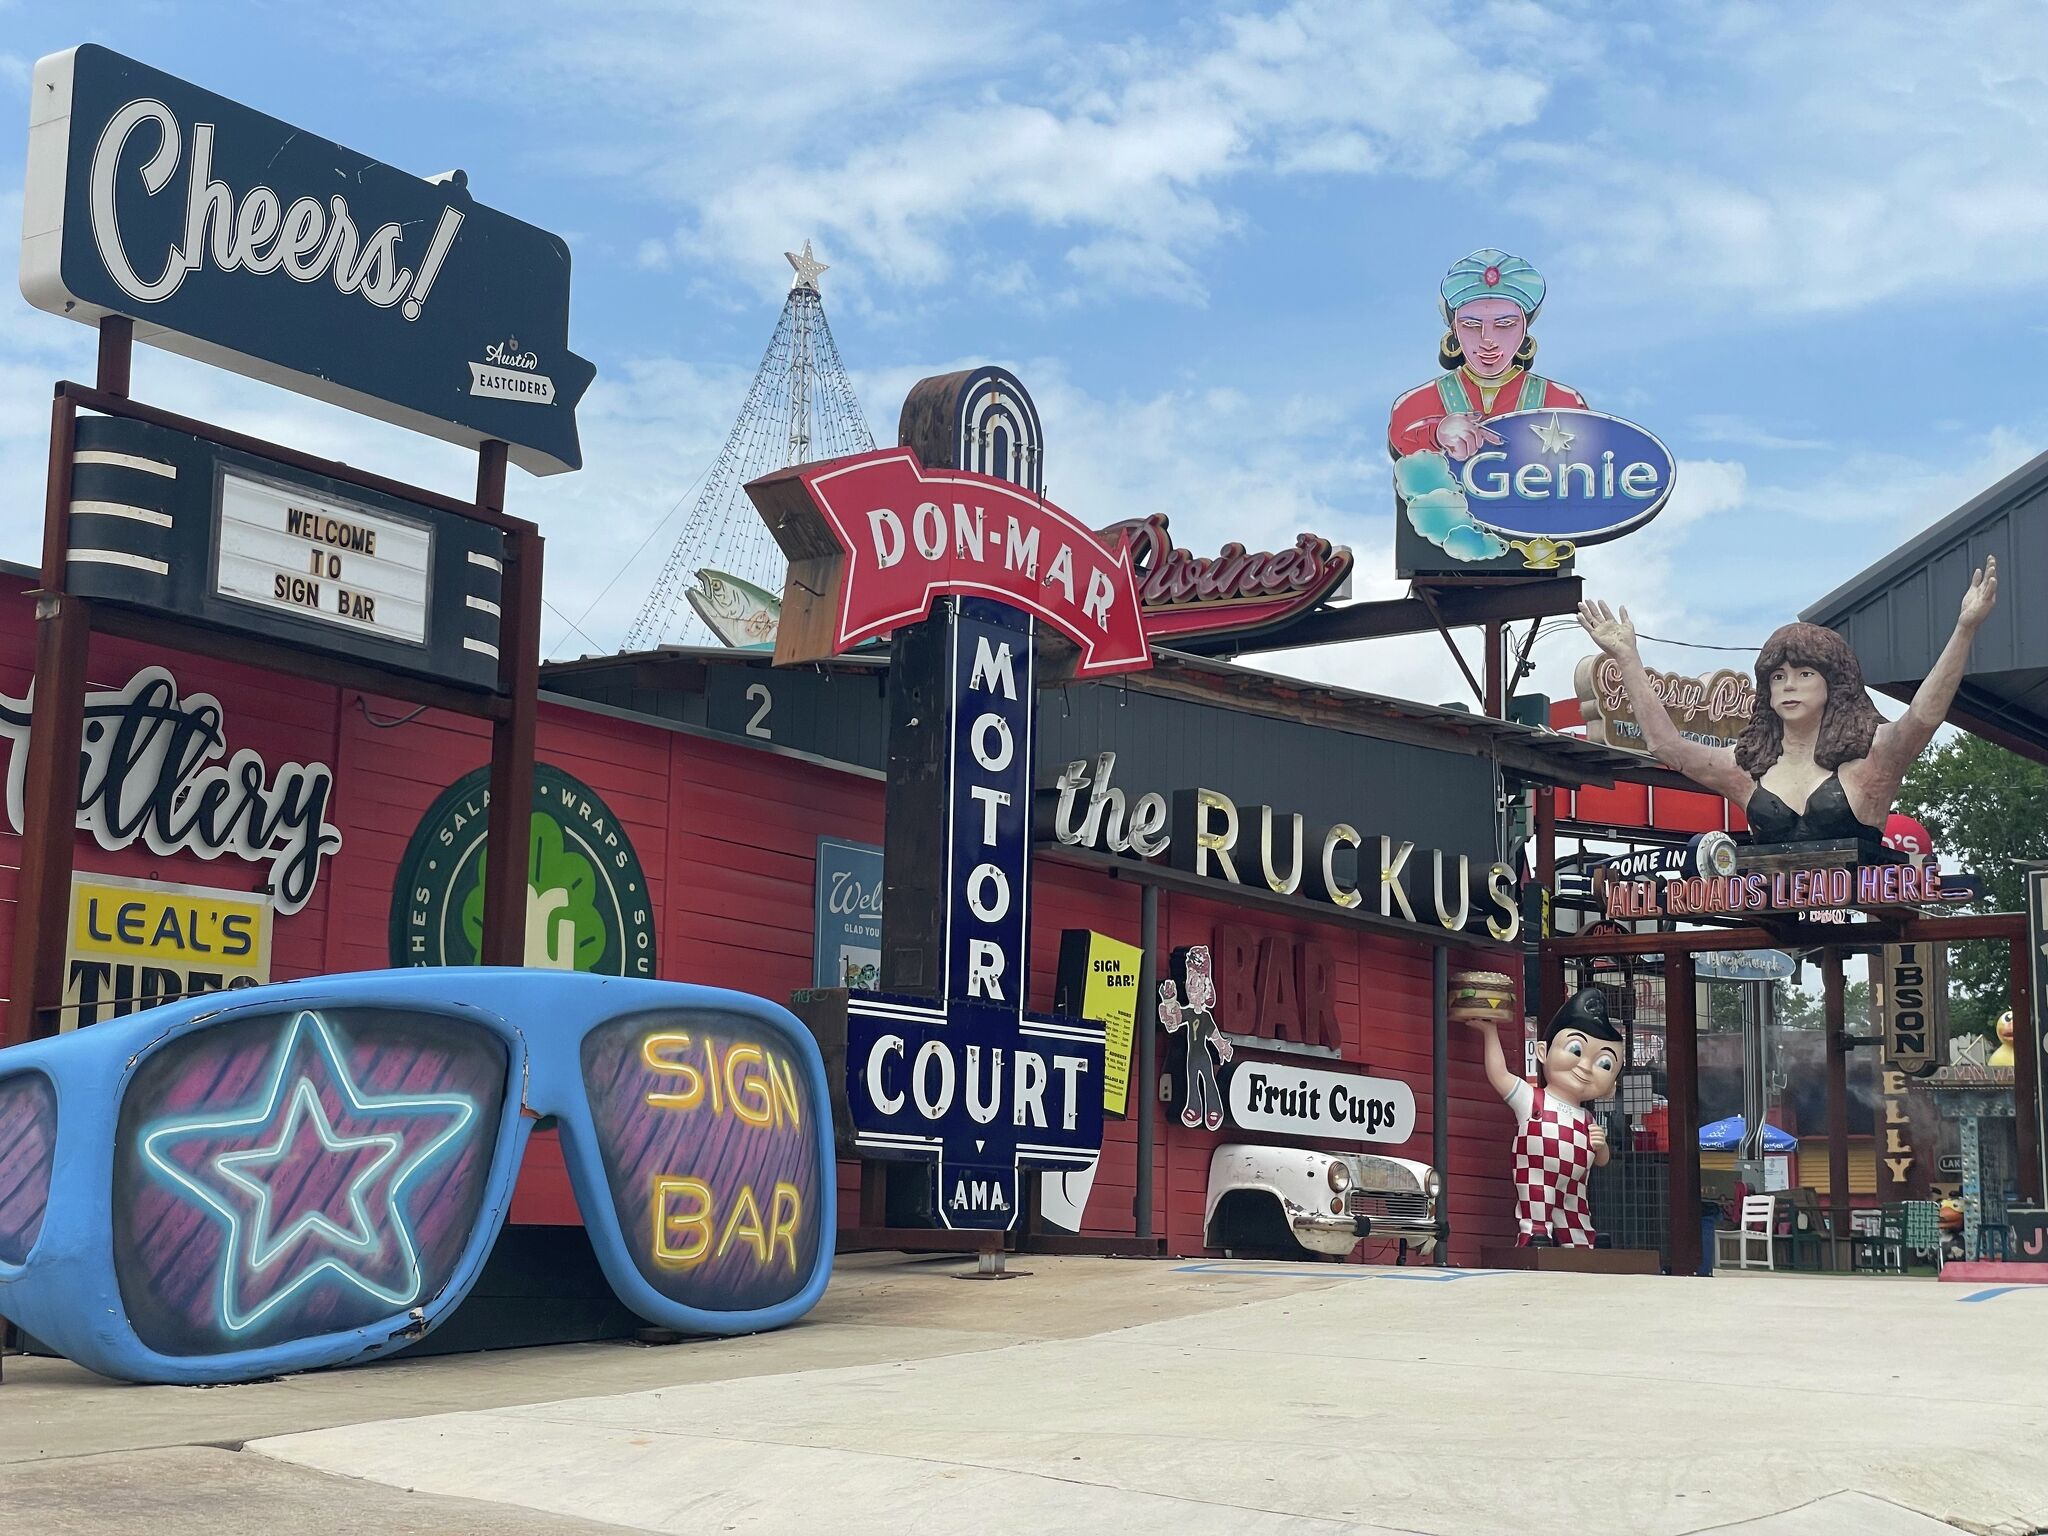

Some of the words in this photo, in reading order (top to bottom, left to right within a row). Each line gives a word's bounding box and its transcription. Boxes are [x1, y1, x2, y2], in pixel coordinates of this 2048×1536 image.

[90, 98, 465, 321] Cheers!
[486, 341, 538, 371] Austin
[480, 373, 548, 397] EASTCIDERS
[1462, 451, 1662, 500] Genie
[287, 507, 376, 555] WELCOME
[311, 548, 342, 579] TO
[866, 502, 1114, 634] DON-MAR
[274, 575, 319, 609] SIGN
[338, 589, 375, 623] BAR
[744, 684, 772, 741] 2
[0, 668, 341, 912] illery
[440, 790, 491, 846] SALA
[967, 636, 1018, 1001] MOTOR
[561, 788, 627, 868] WRAPS
[1055, 752, 1171, 857] the
[1195, 787, 1522, 942] RUCKUS
[1666, 850, 1687, 868] IN
[829, 871, 883, 914] Wel
[1608, 881, 1663, 918] ALL
[1667, 873, 1767, 915] ROADS
[1772, 868, 1851, 909] LEAD
[1857, 862, 1941, 904] HERE
[88, 898, 252, 955] LEAL'S
[412, 886, 431, 967] HES
[633, 909, 649, 973] SOU
[844, 923, 863, 935] GLAD
[865, 927, 880, 937] YOU
[1093, 960, 1120, 973] SIGN
[1107, 974, 1135, 987] BAR!
[1215, 925, 1341, 1050] BAR
[1893, 944, 1926, 1054] IBSON
[641, 1032, 800, 1132] SIGN
[866, 1034, 1089, 1131] COURT
[1248, 1074, 1320, 1121] Fruit
[1329, 1085, 1396, 1135] Cups
[1882, 1071, 1914, 1182] ELLY
[655, 1176, 801, 1272] BAR
[953, 1180, 1005, 1211] AMA
